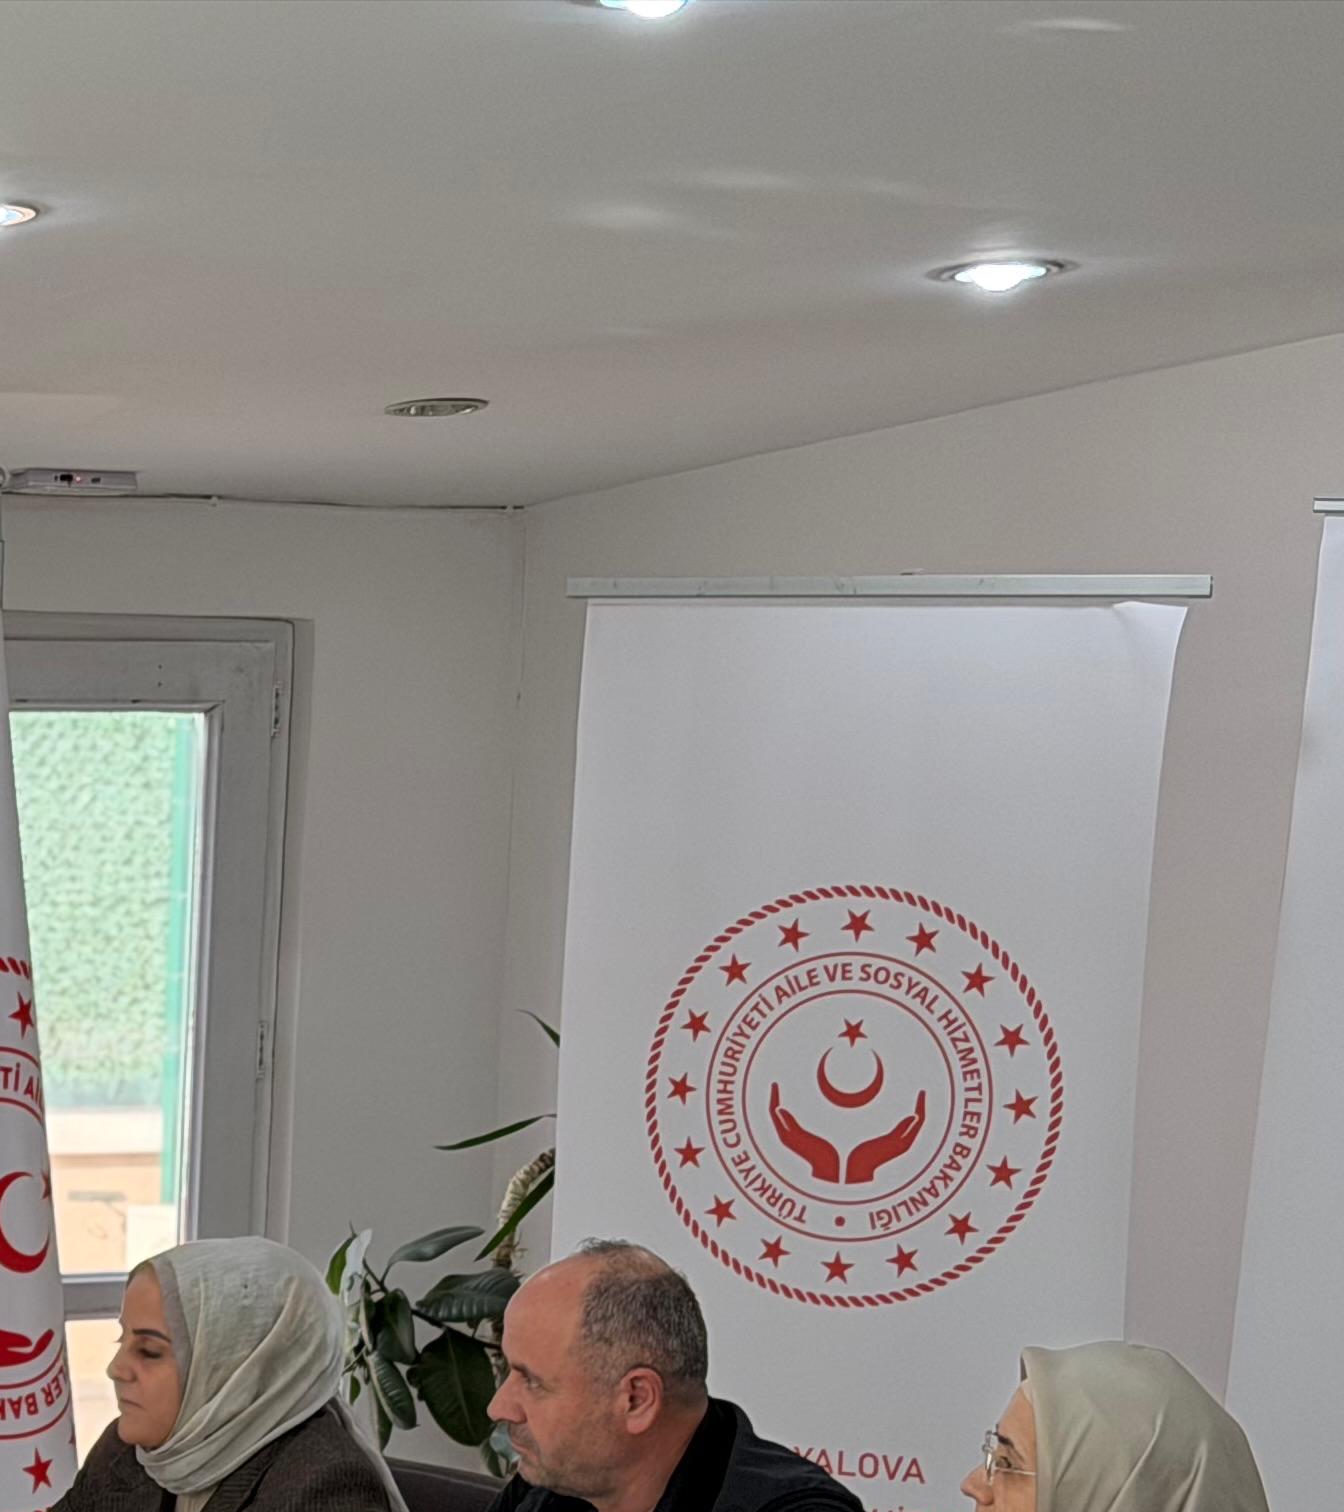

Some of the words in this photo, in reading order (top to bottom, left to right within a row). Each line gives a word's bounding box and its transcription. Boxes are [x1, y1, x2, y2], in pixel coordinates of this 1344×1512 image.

[774, 967, 820, 1005] AİLE
[823, 962, 853, 983] VE
[858, 962, 940, 1015] SOSYAL
[716, 993, 775, 1149] CUMHURİYETİ
[936, 1008, 983, 1140] HİZMETLER
[730, 1149, 807, 1224] TÜRKİYE
[868, 1141, 972, 1231] BAKANLIĞI
